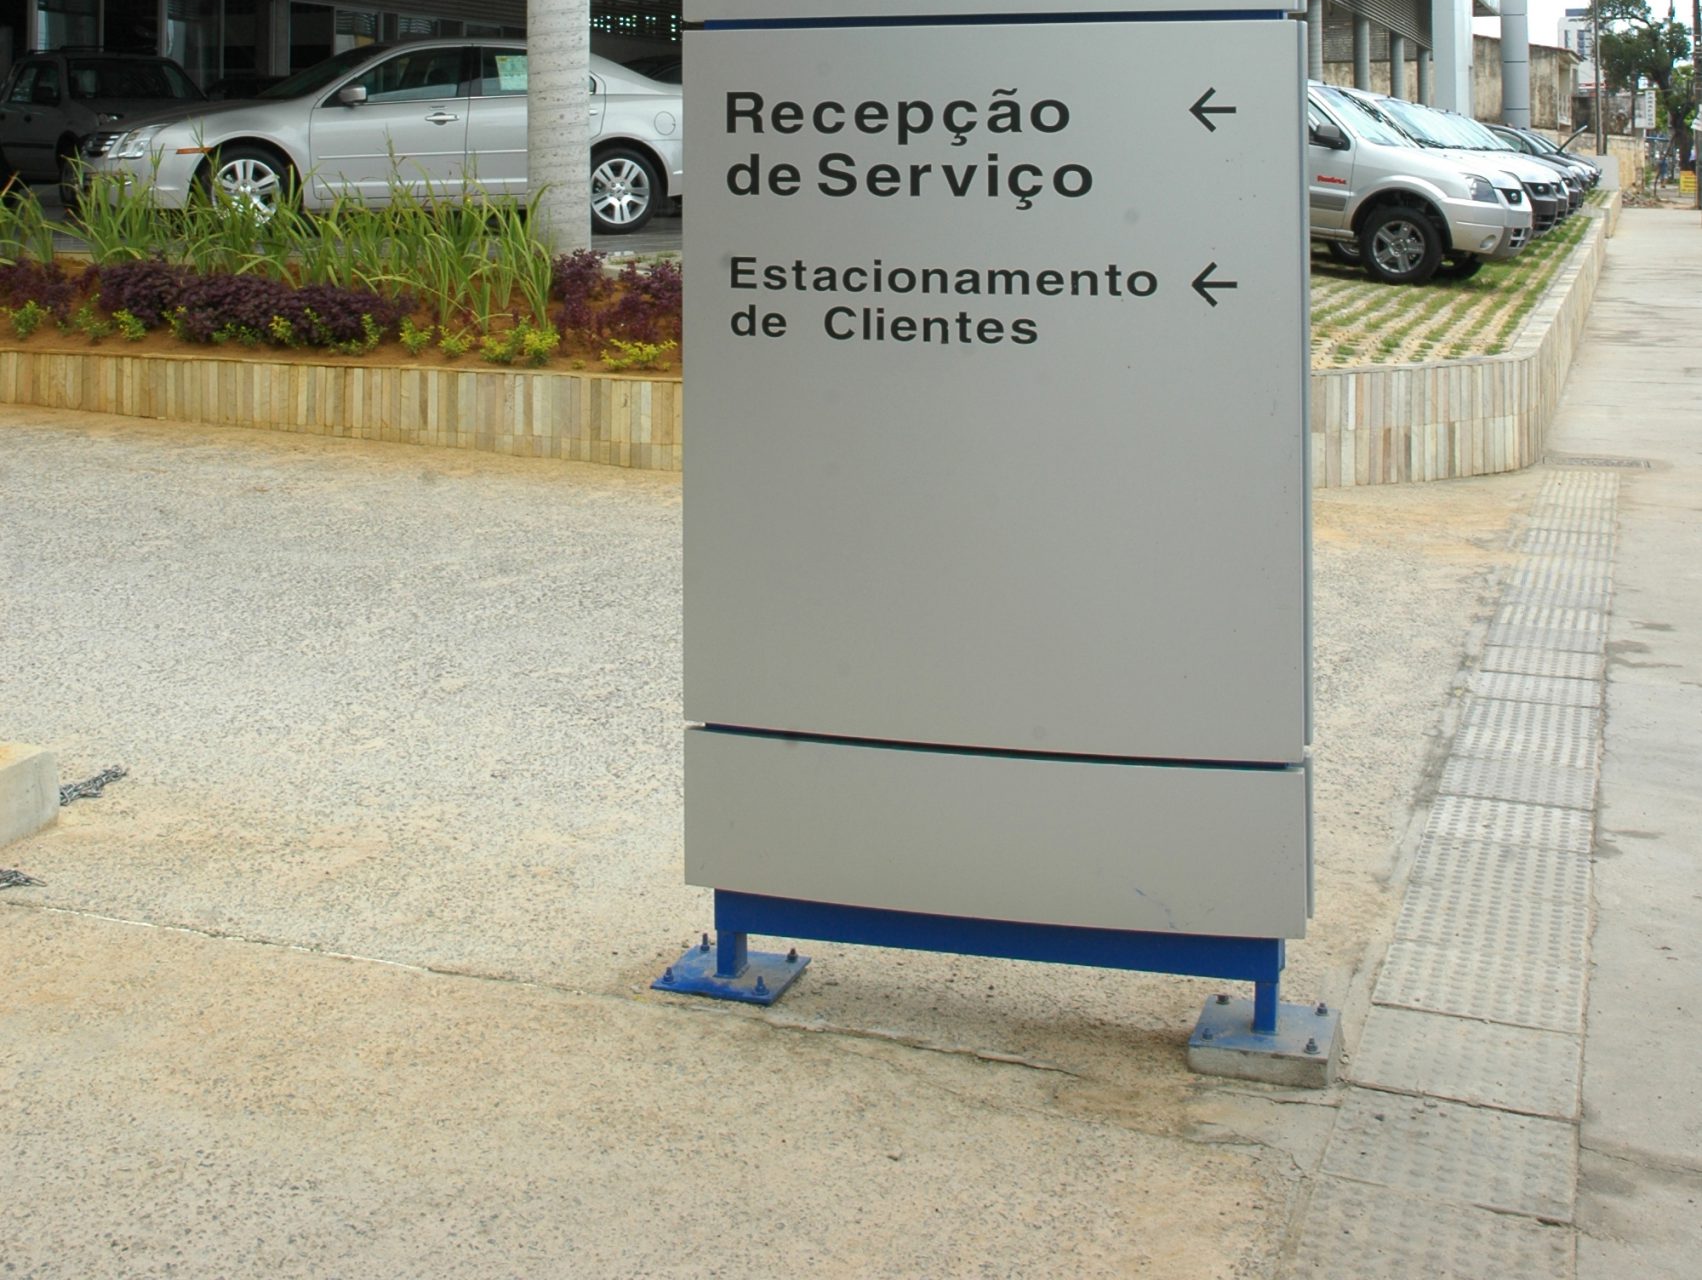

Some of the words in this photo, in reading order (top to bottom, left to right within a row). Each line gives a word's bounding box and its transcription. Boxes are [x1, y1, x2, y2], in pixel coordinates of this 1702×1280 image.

[726, 88, 1070, 147] Recepção
[726, 153, 801, 197] de
[817, 152, 1093, 211] Serviço
[730, 256, 1158, 297] Estacionamento
[730, 304, 787, 338] de
[824, 306, 1038, 345] Clientes
